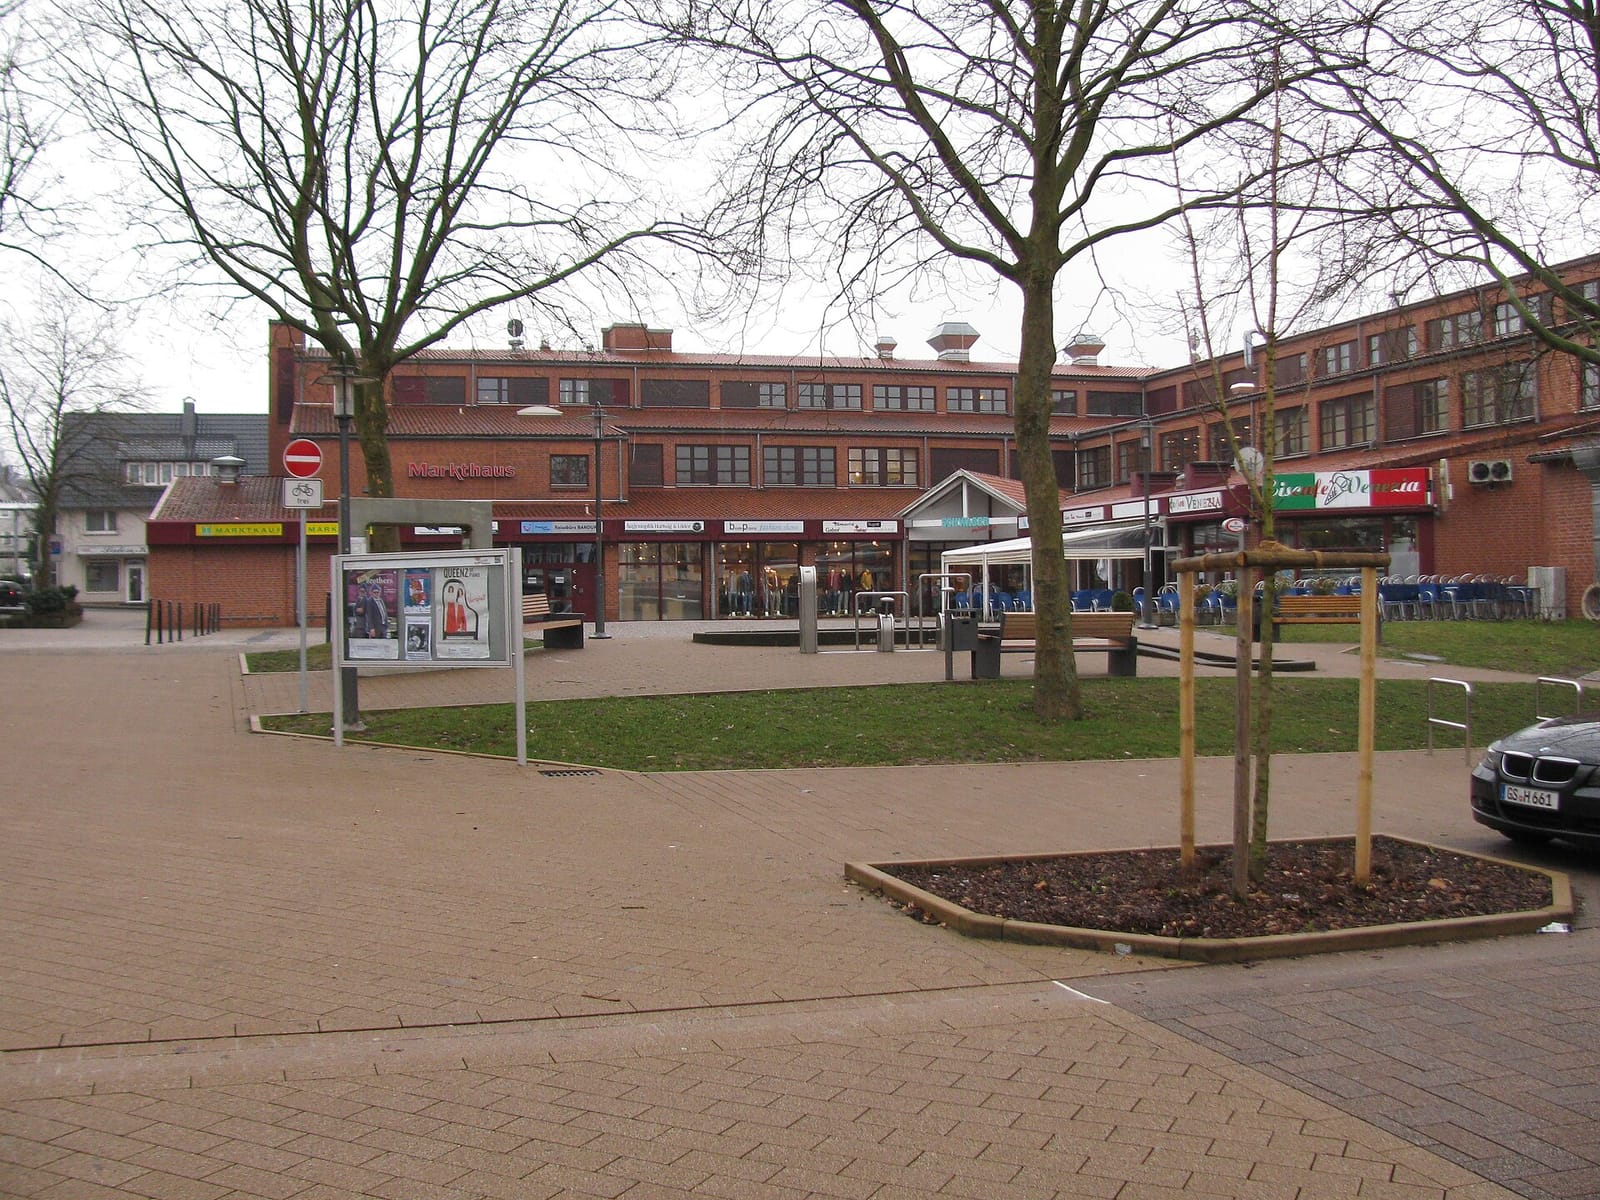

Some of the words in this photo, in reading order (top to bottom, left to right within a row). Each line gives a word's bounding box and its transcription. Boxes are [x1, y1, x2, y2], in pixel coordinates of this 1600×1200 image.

[408, 462, 516, 481] Markthaus
[1347, 475, 1421, 494] Venezia
[297, 497, 309, 505] frei
[443, 567, 469, 578] QUEENZ
[1507, 786, 1518, 801] GS
